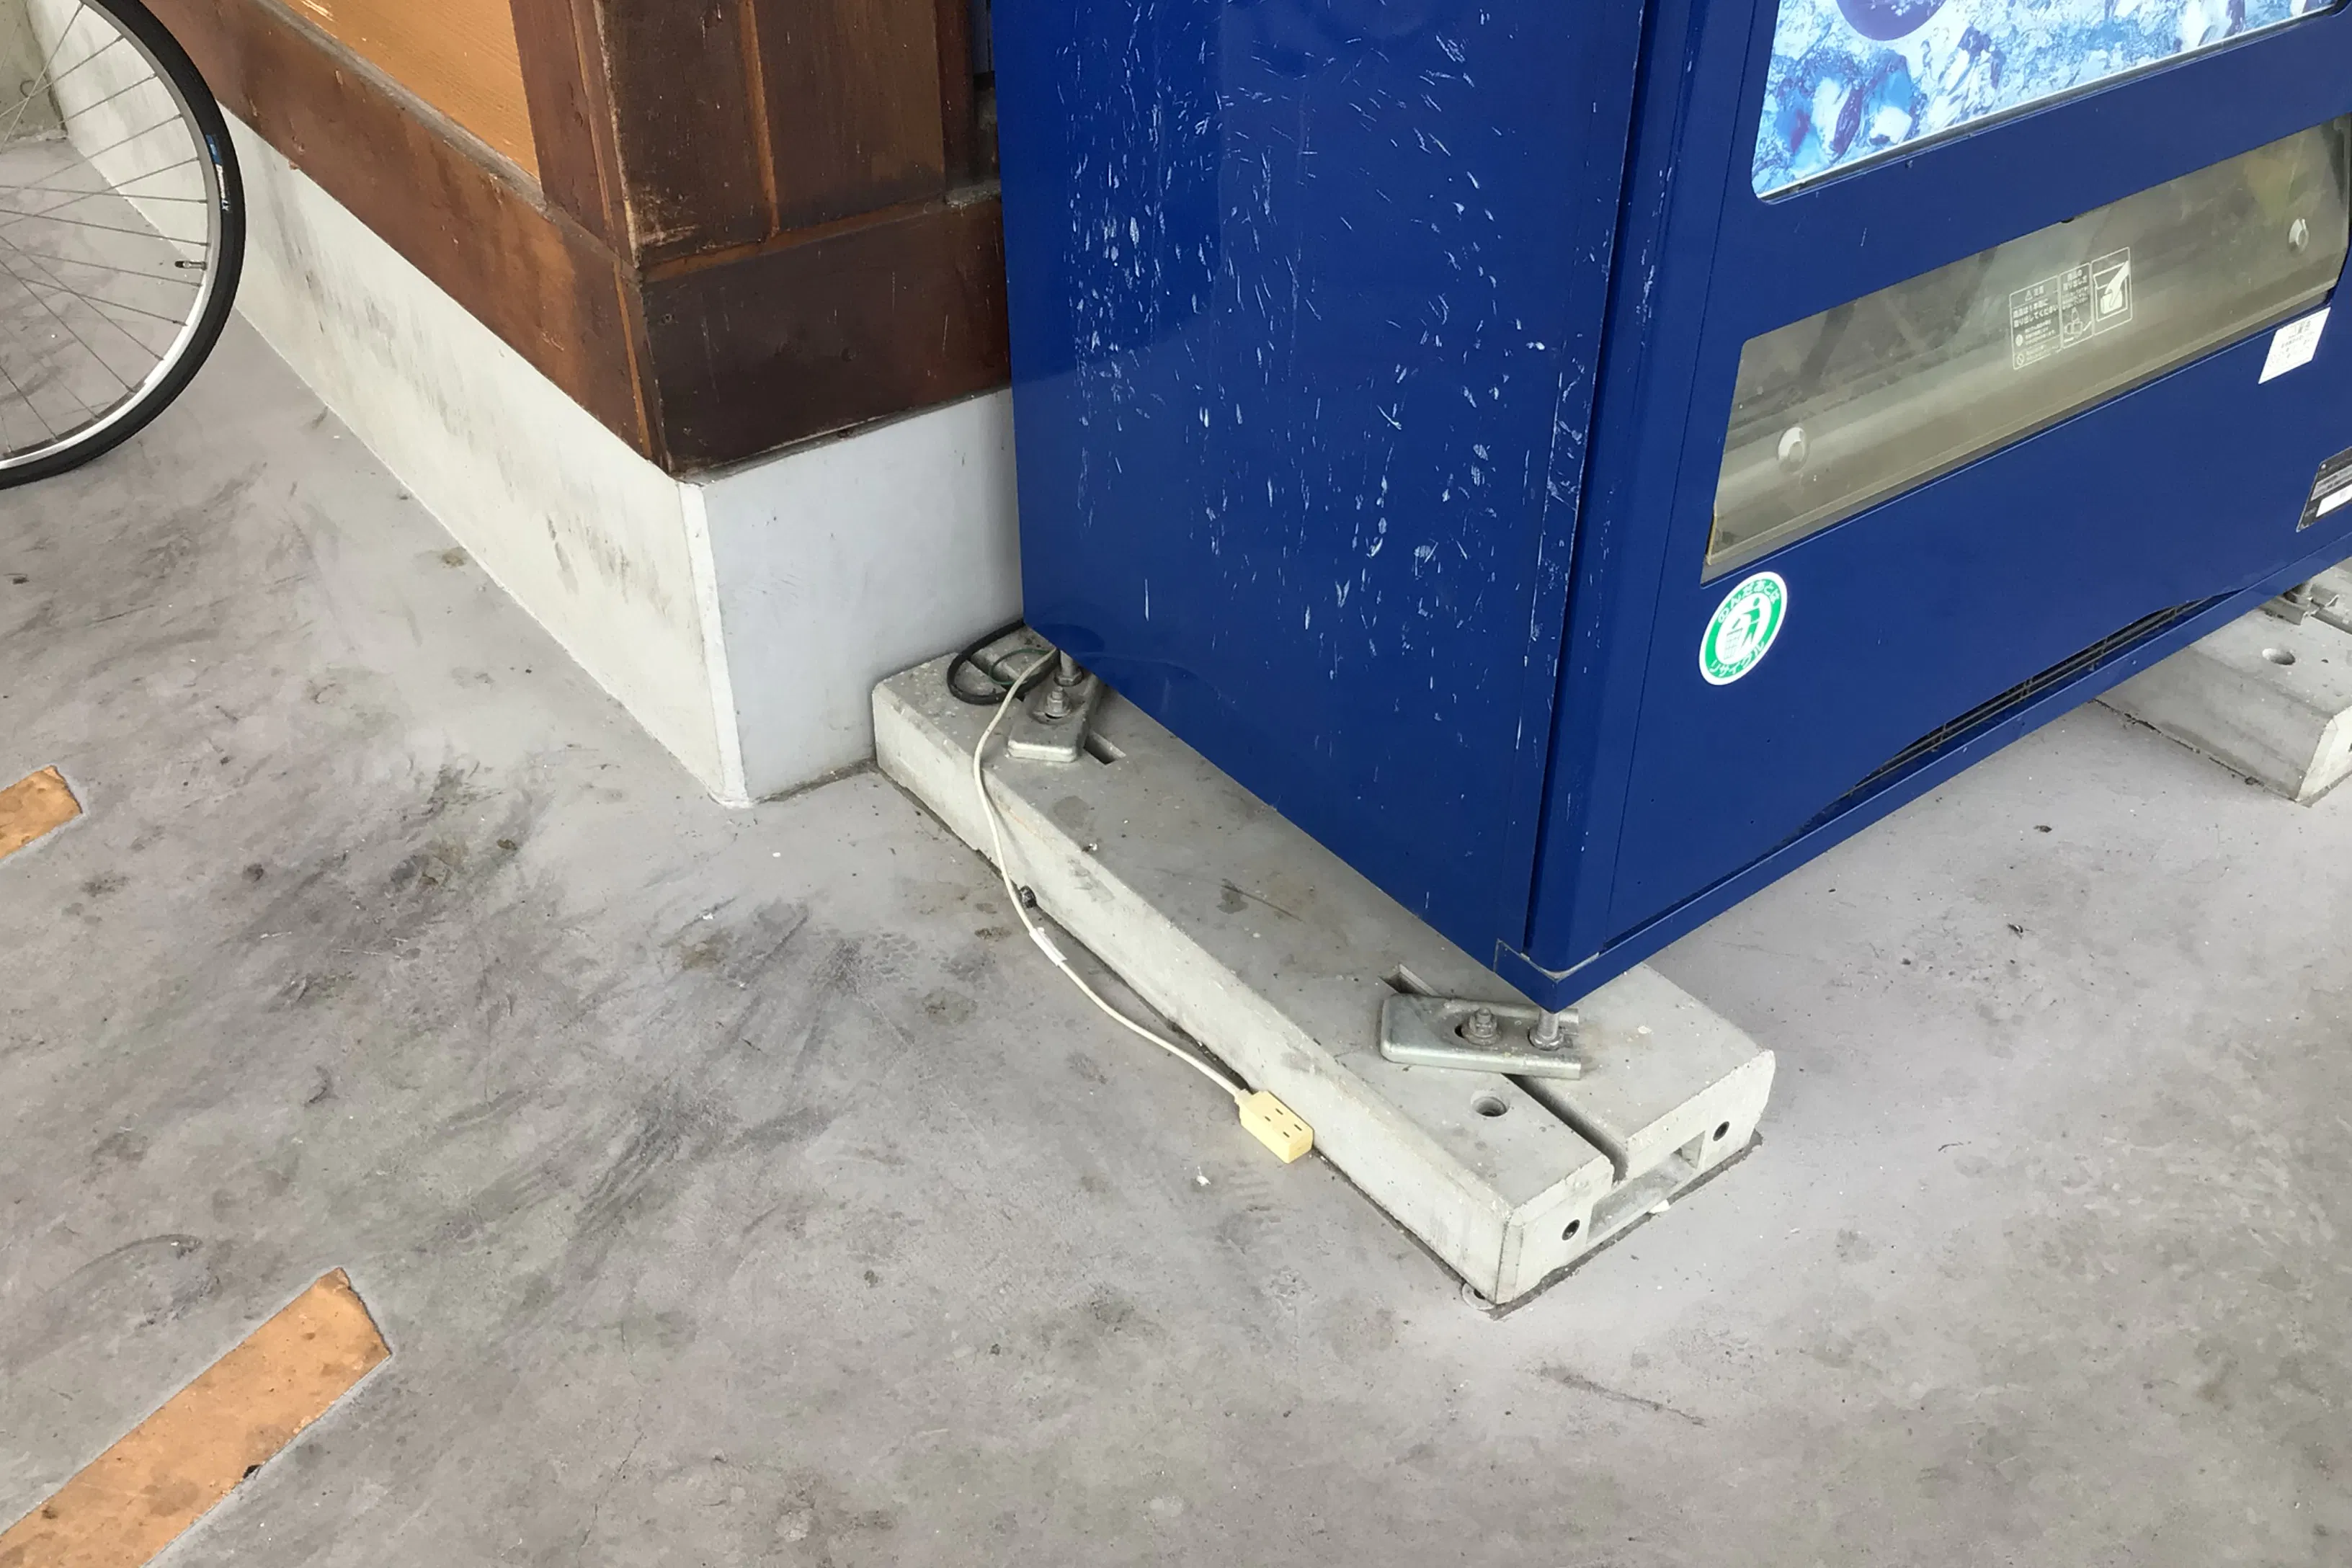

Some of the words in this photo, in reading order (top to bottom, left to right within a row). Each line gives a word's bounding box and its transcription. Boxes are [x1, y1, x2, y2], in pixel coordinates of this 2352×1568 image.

[1717, 579, 1780, 623] のんだあとは
[1709, 641, 1765, 677] リサイクル
